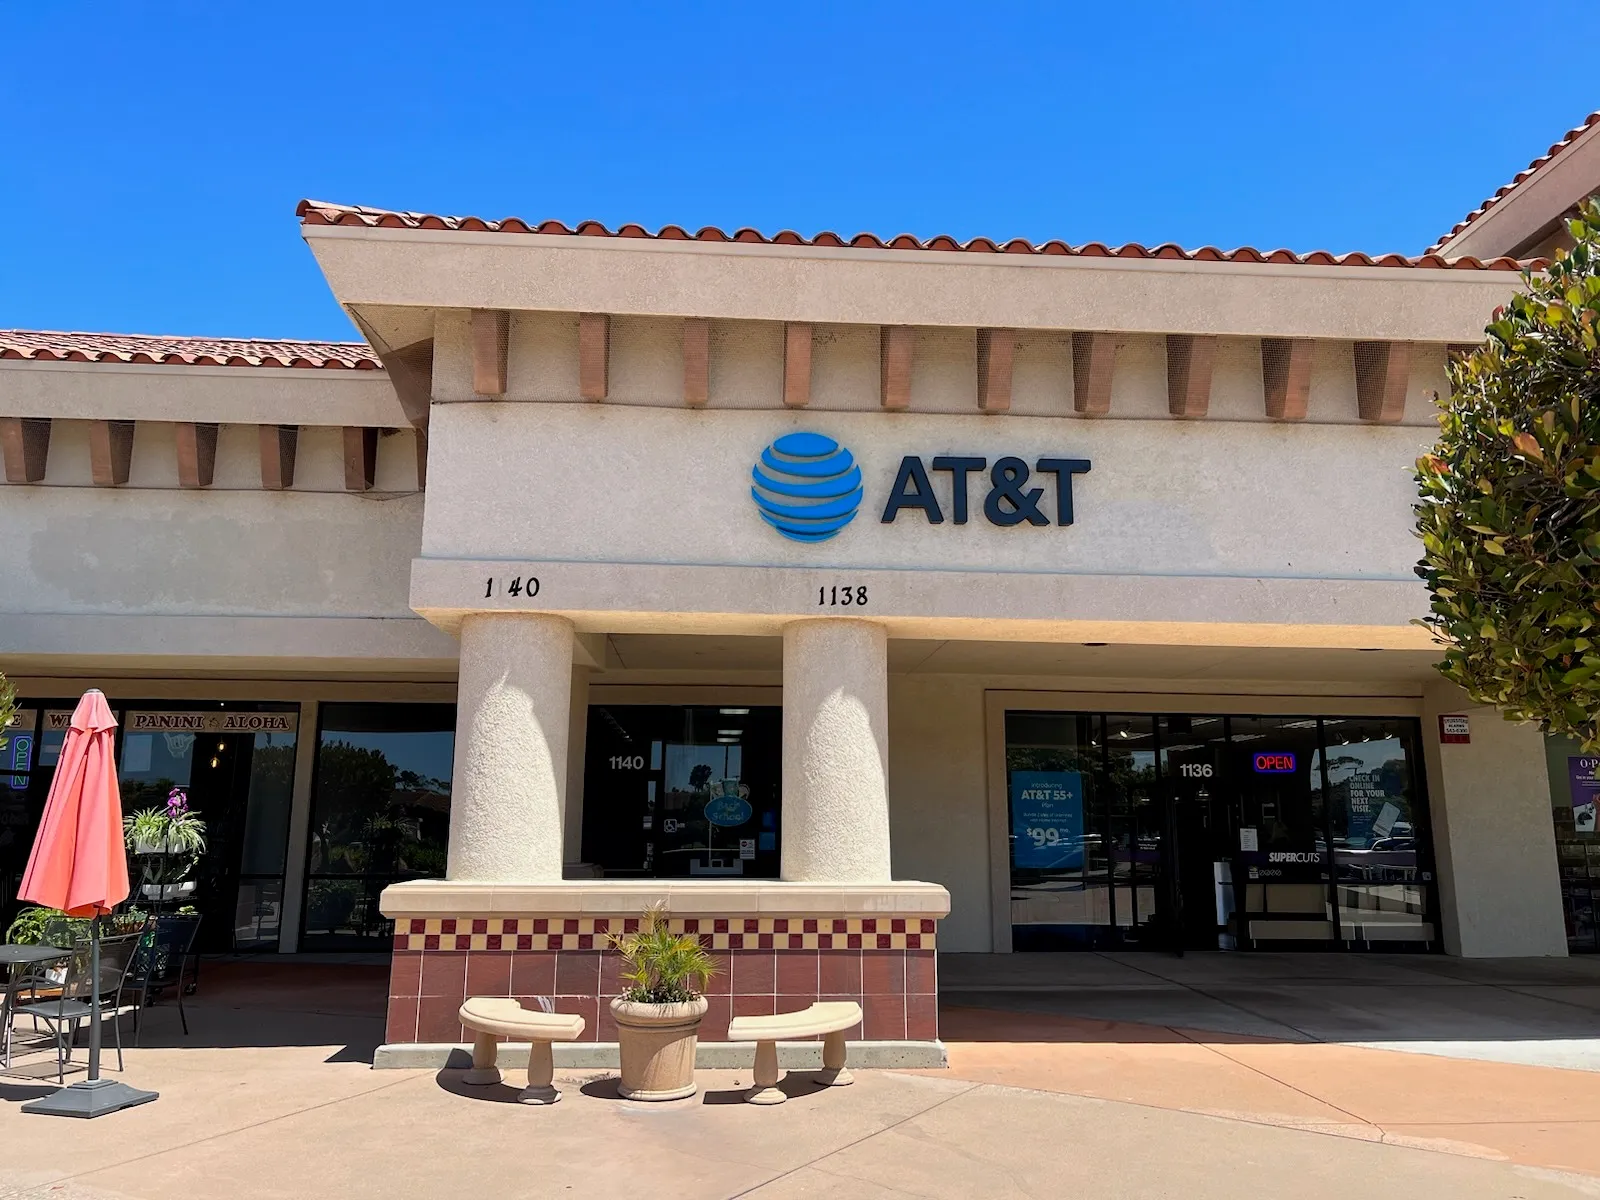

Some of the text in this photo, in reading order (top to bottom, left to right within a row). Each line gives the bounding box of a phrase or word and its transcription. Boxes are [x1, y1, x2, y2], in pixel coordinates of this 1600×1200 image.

[880, 456, 1092, 528] AT&T
[818, 585, 868, 606] 1138
[134, 714, 290, 729] PANINI ALOHA
[609, 756, 644, 770] 1140
[1256, 756, 1293, 769] OPEN
[1180, 763, 1213, 778] 1136
[1349, 774, 1380, 782] CHECK IN
[1021, 789, 1073, 800] AT&T 55+
[1350, 789, 1385, 797] FOR YOUR
[1351, 797, 1369, 805] NEXT
[1269, 852, 1320, 862] SUPERCUTS
